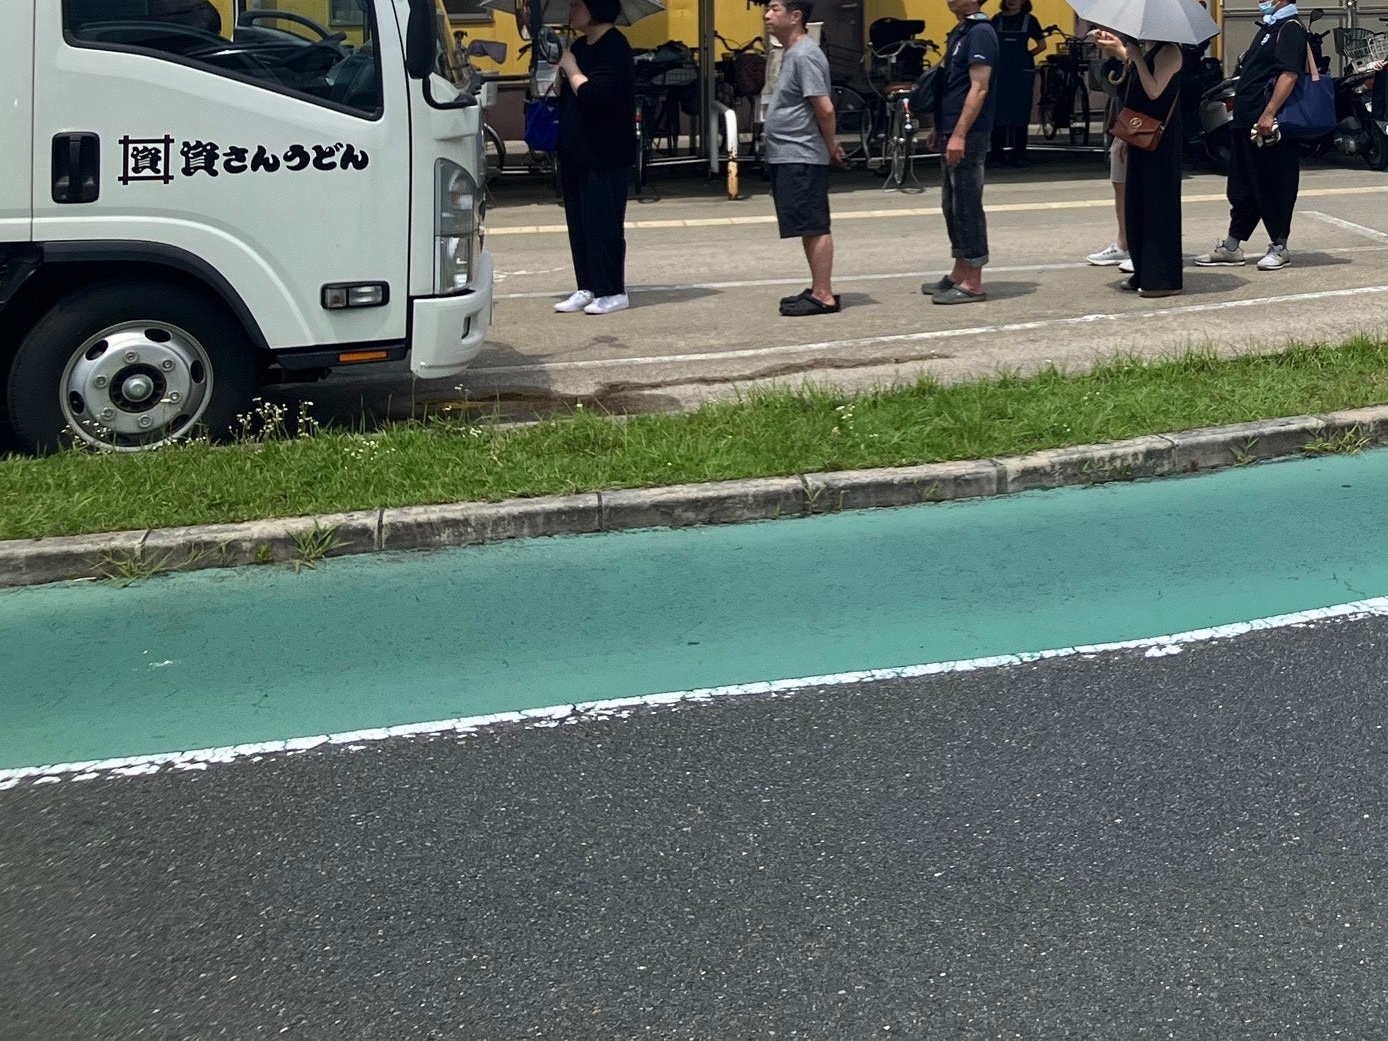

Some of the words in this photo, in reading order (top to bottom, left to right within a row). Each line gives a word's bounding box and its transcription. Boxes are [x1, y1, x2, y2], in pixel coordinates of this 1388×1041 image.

[180, 140, 369, 177] 資さんうどん
